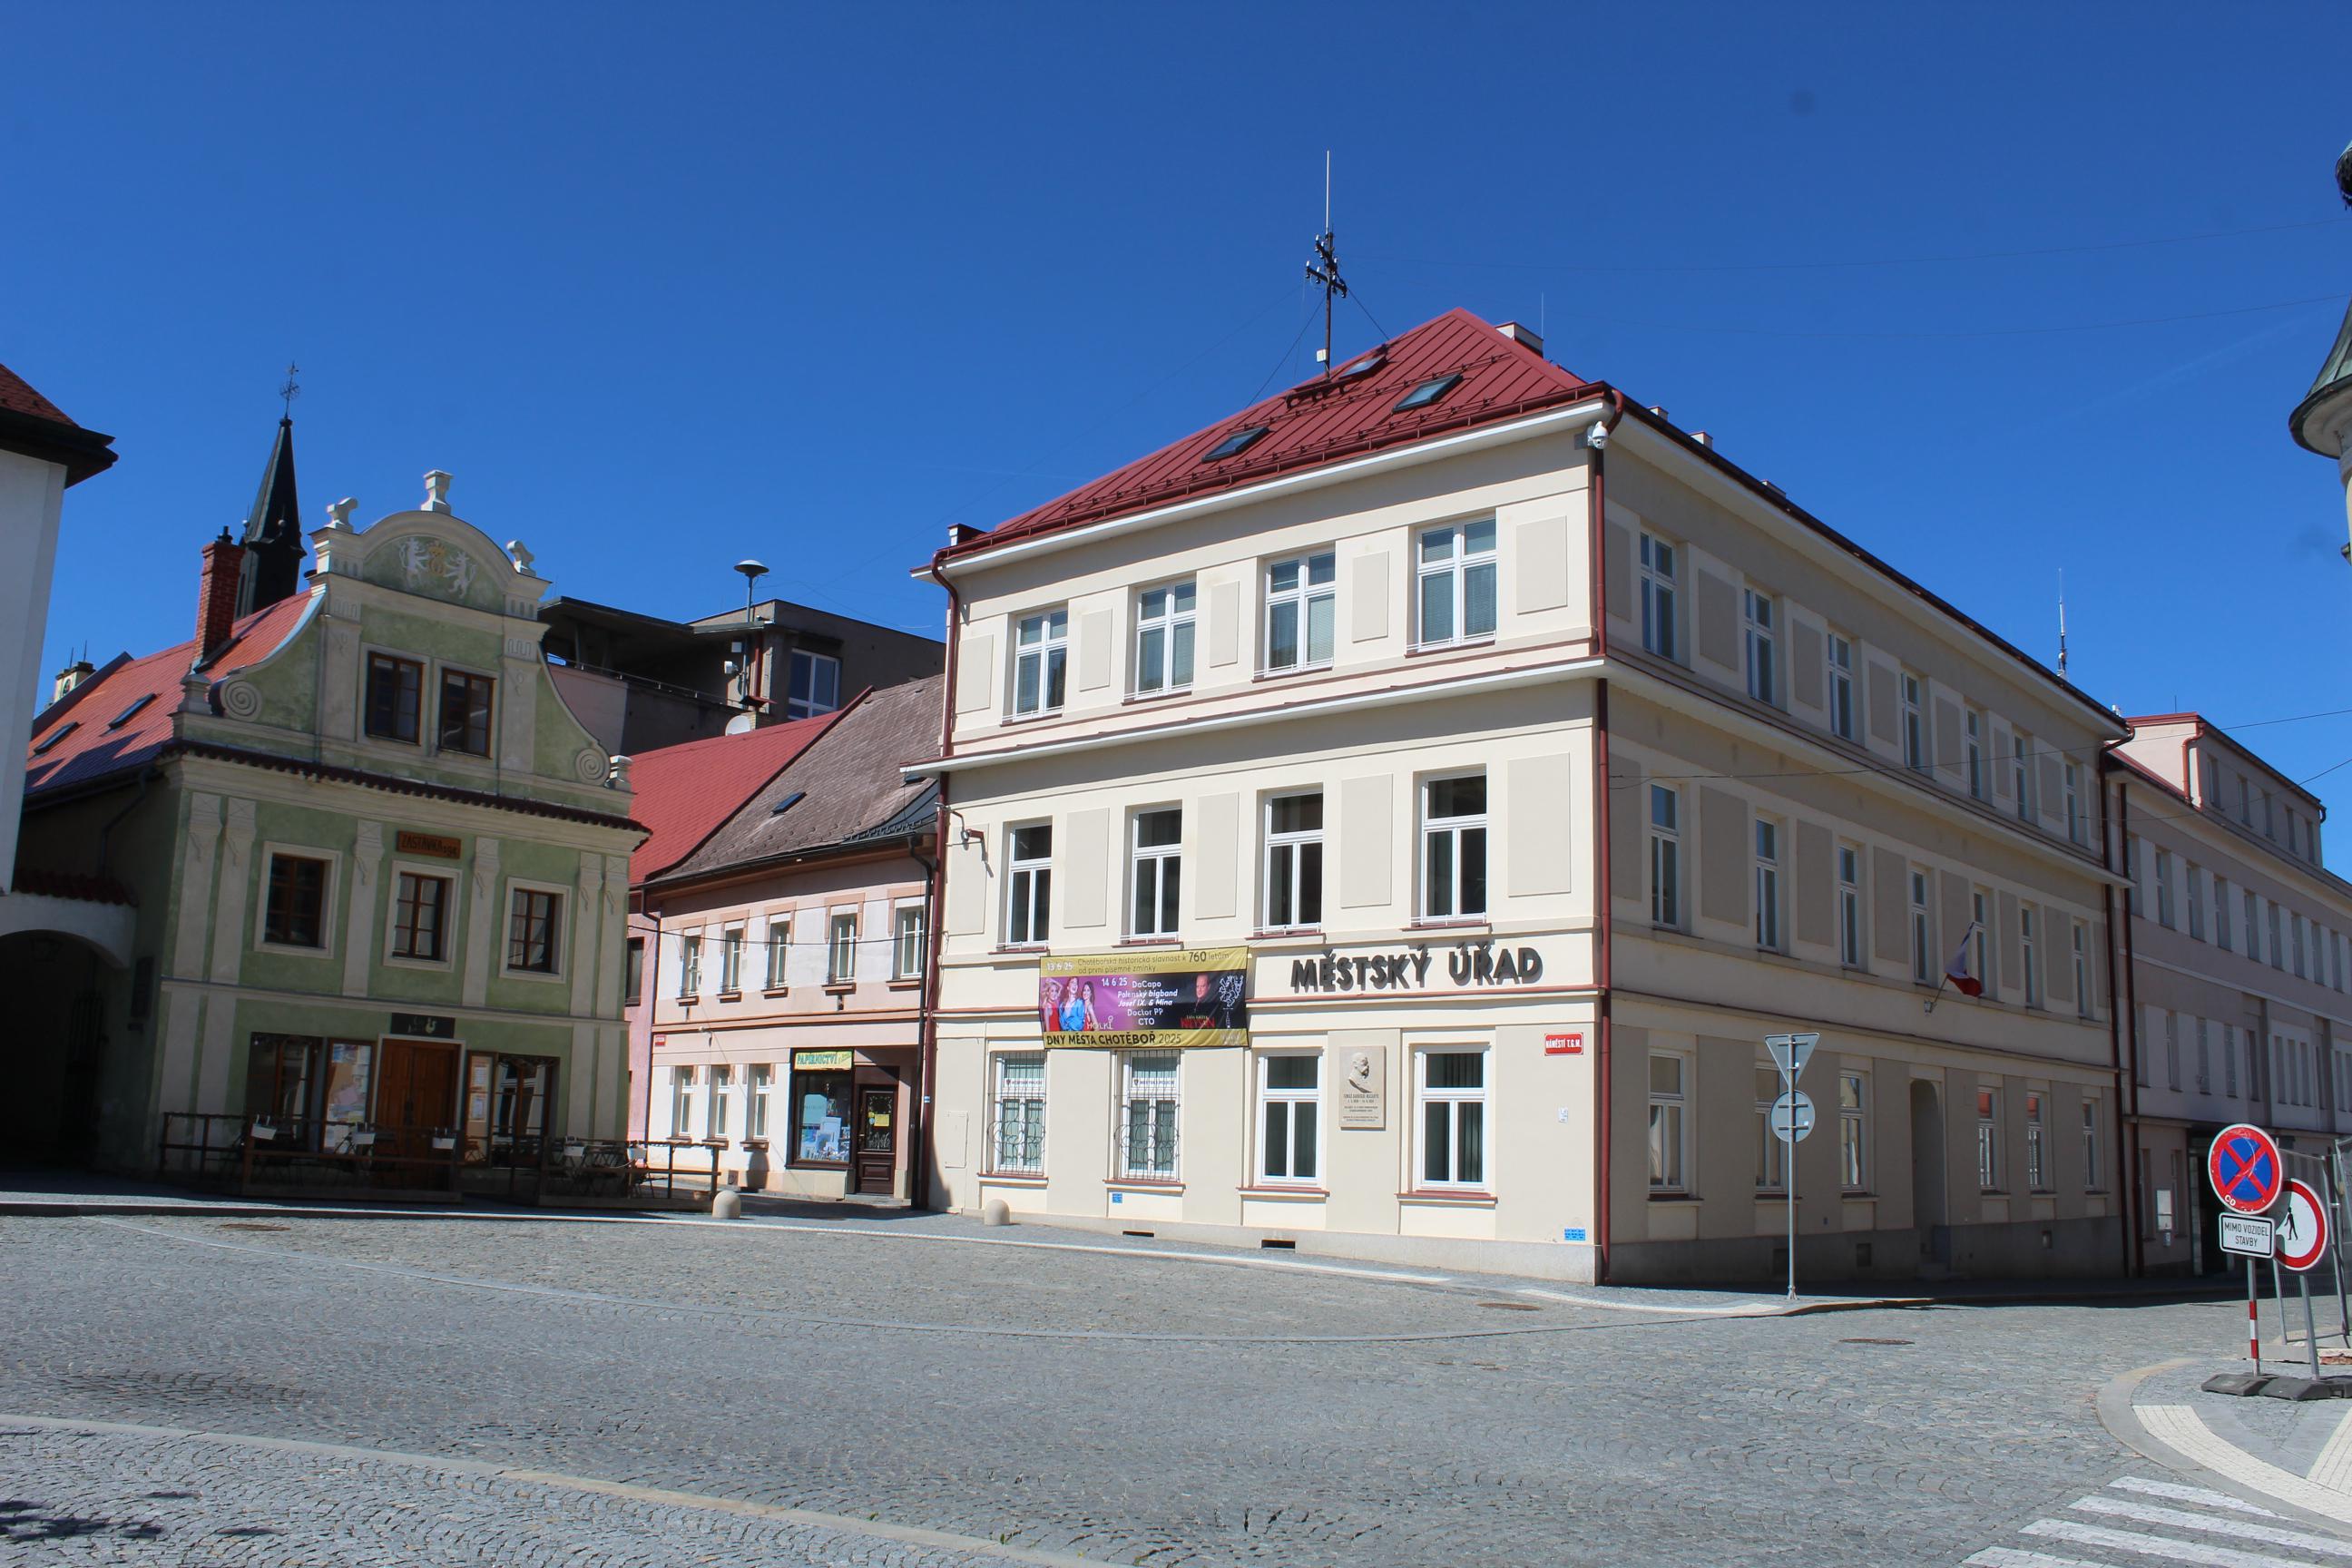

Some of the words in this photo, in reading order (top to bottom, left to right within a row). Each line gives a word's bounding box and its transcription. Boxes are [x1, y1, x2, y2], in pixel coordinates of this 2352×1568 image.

[1152, 955, 1181, 963] slavnost
[1189, 951, 1207, 963] 760
[1208, 952, 1230, 960] letům
[1088, 966, 1103, 975] první
[1132, 965, 1156, 973] zmínky
[1290, 944, 1431, 993] MĚSTSKÝ
[1448, 941, 1544, 986] ÚŘAD
[1119, 977, 1127, 986] 25
[1132, 981, 1161, 989] DaCapo
[1148, 989, 1178, 999] bigband
[1118, 999, 1135, 1007] Josef
[1138, 1017, 1155, 1025] CTO
[1046, 1034, 1065, 1045] DNY
[1068, 1032, 1096, 1045] MĚSTA
[1098, 1031, 1156, 1044] CHOTĚBOŘ
[1159, 1033, 1181, 1044] 2025
[1545, 1038, 1566, 1048] NÁMĚSTÍ
[2224, 1221, 2241, 1233] MIMO
[2242, 1224, 2269, 1237] VOZIDEL
[2235, 1235, 2258, 1247] STAVBY
